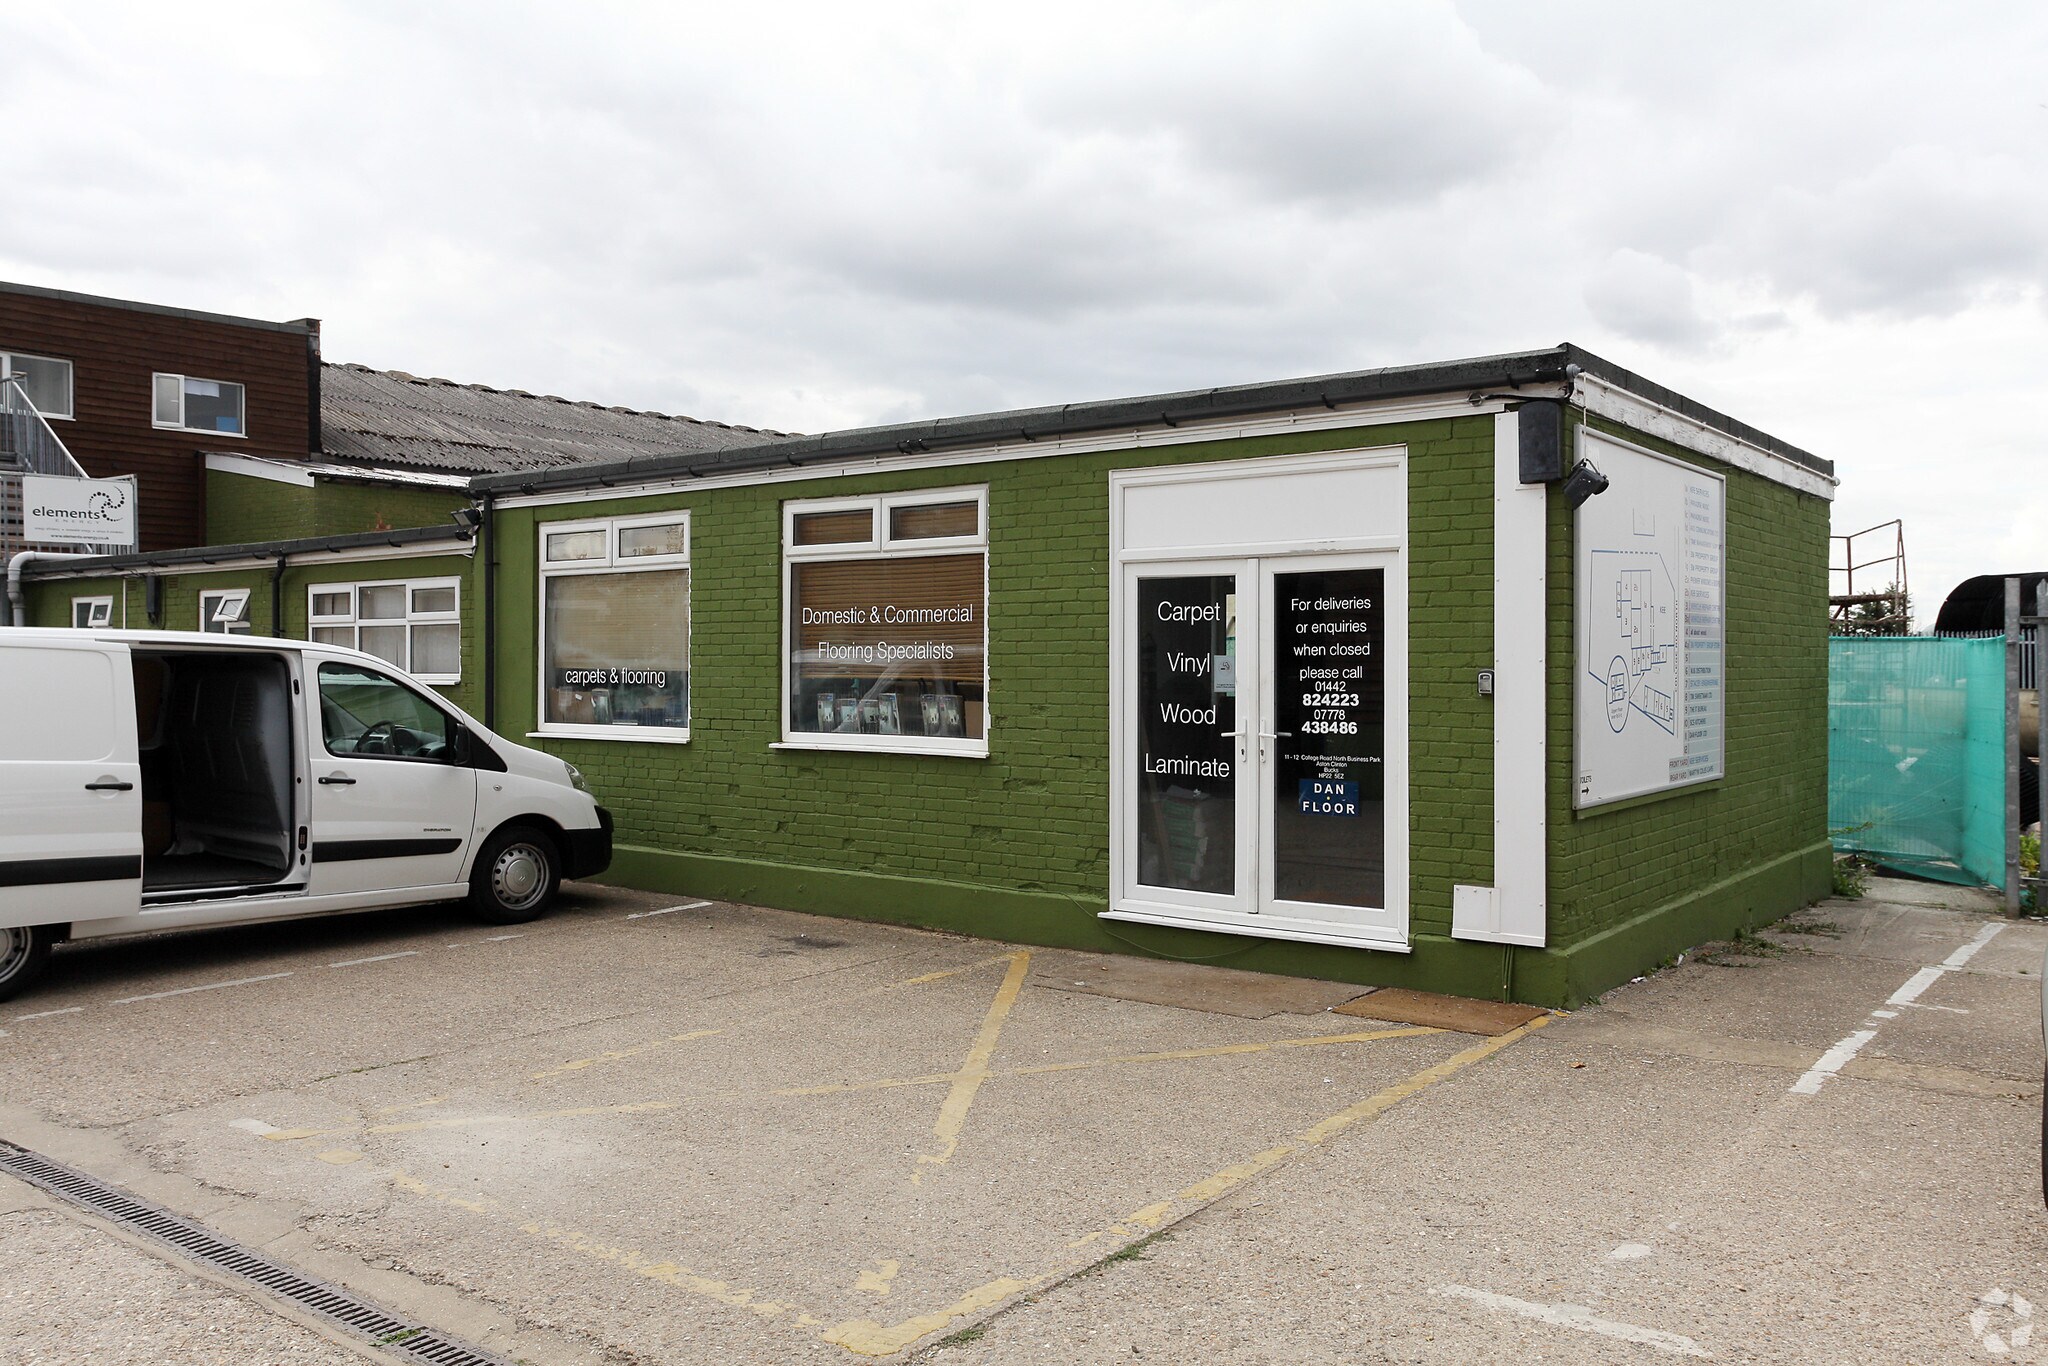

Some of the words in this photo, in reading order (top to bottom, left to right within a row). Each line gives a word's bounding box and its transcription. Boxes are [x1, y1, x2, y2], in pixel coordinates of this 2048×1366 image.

[33, 506, 100, 520] elements
[1291, 598, 1310, 611] For
[1314, 597, 1371, 610] deliveries
[802, 608, 866, 625] Domestic
[869, 607, 880, 623] &
[884, 604, 973, 623] Commercial
[1158, 600, 1220, 625] Carpet
[1296, 623, 1308, 633] or
[1312, 620, 1367, 635] enquiries
[818, 641, 874, 663] Flooring
[877, 641, 954, 662] Specialists
[1294, 644, 1326, 656] when
[1330, 643, 1370, 656] closed
[1167, 652, 1210, 676] Vinyl
[565, 668, 606, 686] carpets
[609, 668, 619, 684] &
[621, 668, 665, 688] flooring
[1299, 667, 1339, 681] please
[1343, 666, 1363, 678] call
[1315, 681, 1346, 692] 01442
[1302, 694, 1359, 707] 824223
[1160, 703, 1216, 725] Wood
[1314, 709, 1345, 720] 07778
[1302, 721, 1357, 734] 438486
[1145, 753, 1229, 778] Laminate
[1314, 783, 1344, 794] DAN
[1303, 801, 1355, 814] FLOOR
